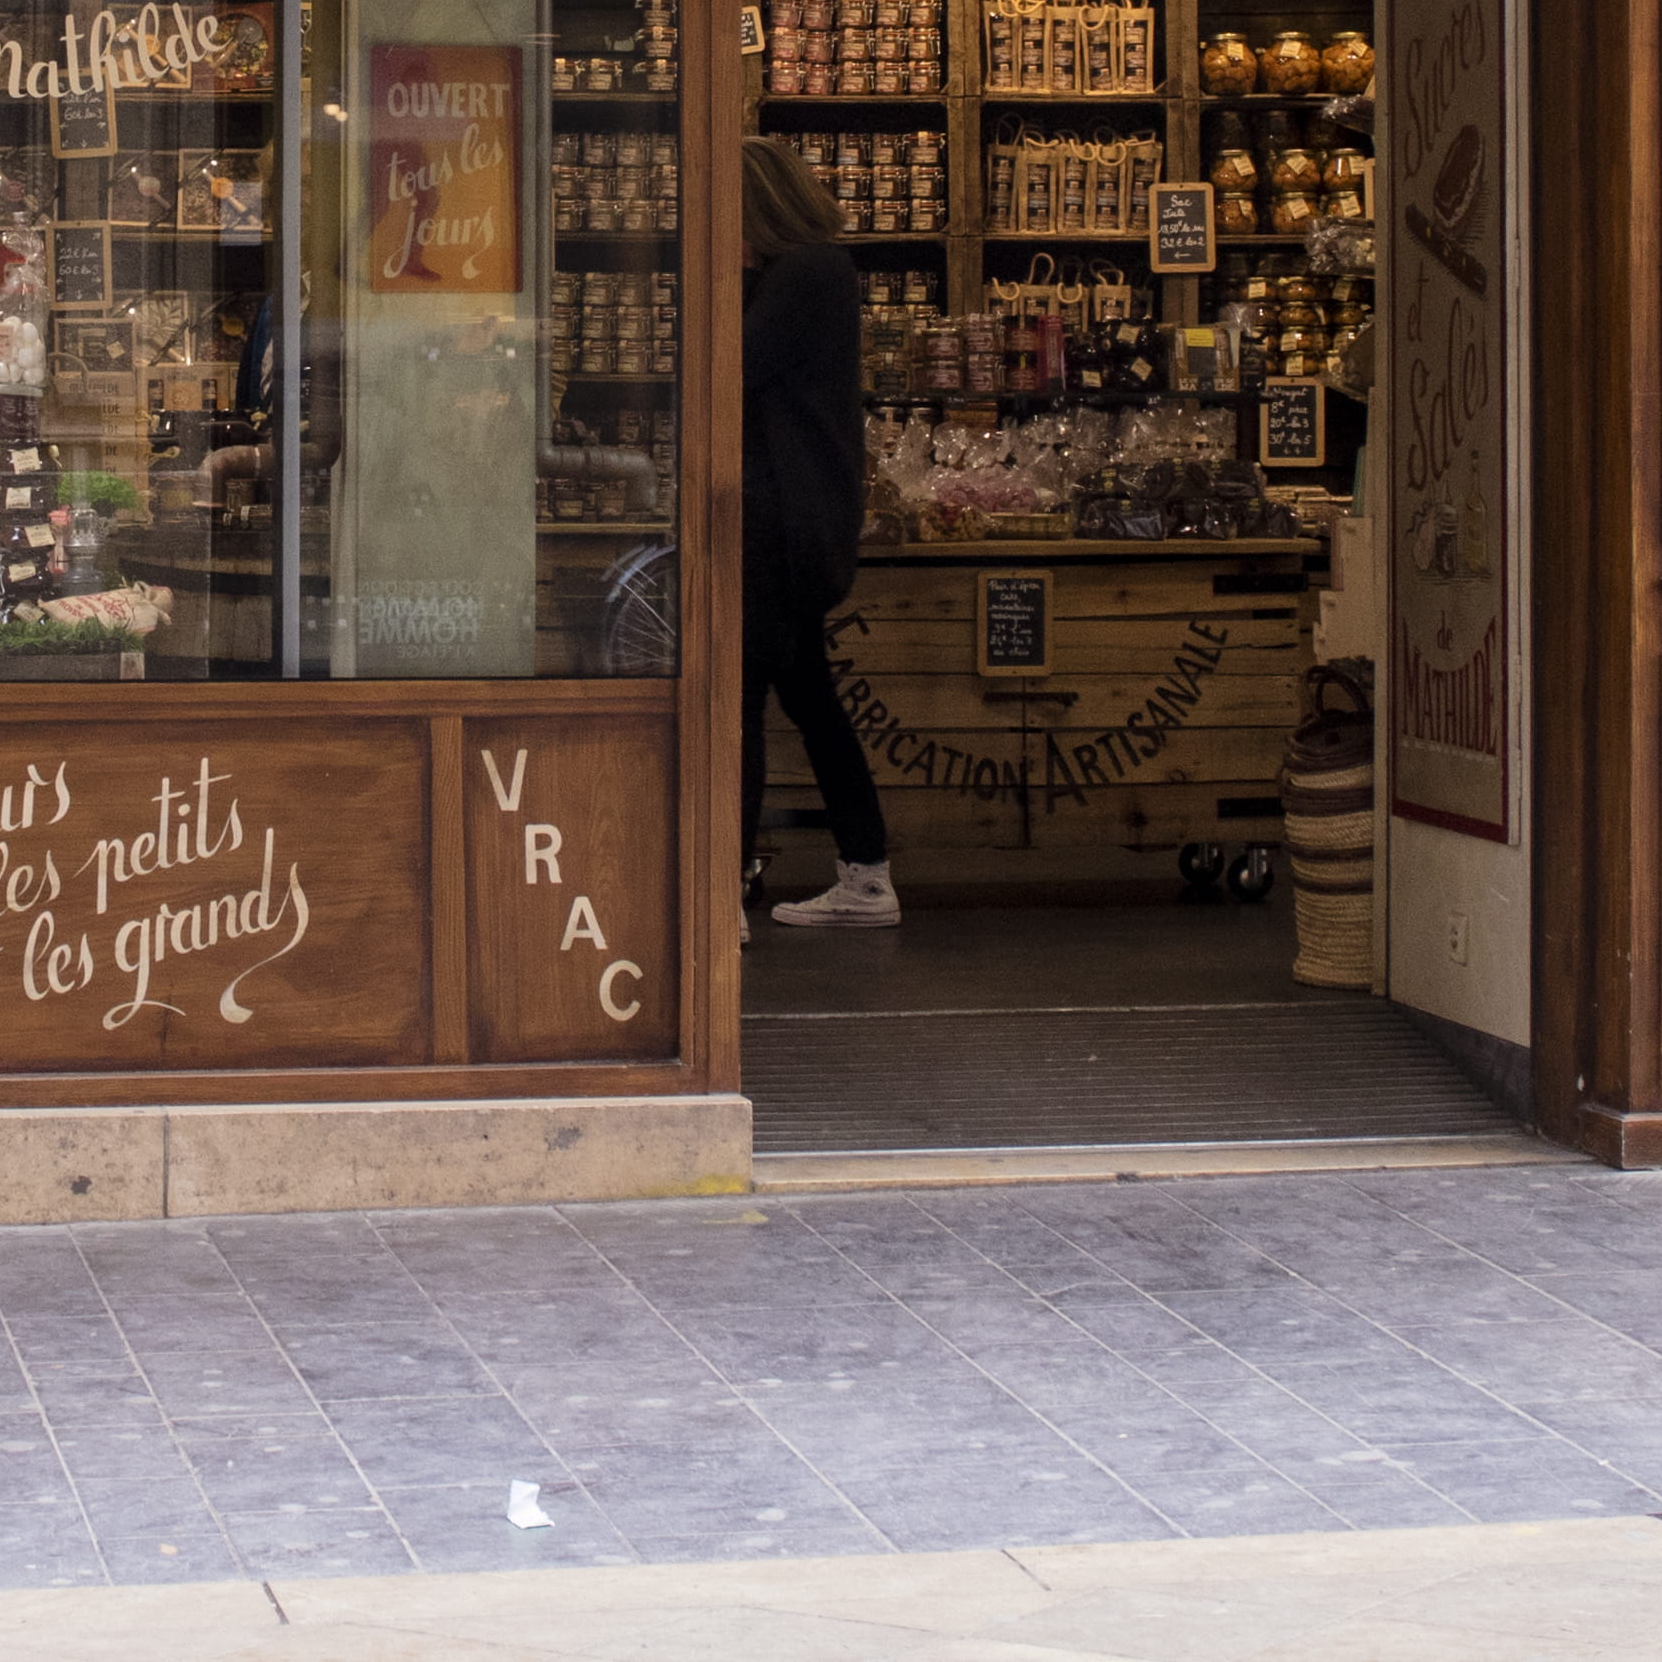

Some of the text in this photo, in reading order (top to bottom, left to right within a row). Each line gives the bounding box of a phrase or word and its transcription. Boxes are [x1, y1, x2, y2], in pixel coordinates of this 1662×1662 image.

[388, 82, 510, 119] OUVERT
[388, 122, 504, 202] tous les
[383, 199, 496, 280] jours
[1045, 619, 1229, 814] ARTISANALE
[1401, 615, 1499, 756] MATHILDE
[75, 757, 245, 914] petits
[480, 748, 642, 1022] VRAC
[23, 916, 92, 1001] les
[103, 828, 308, 1032] grands
